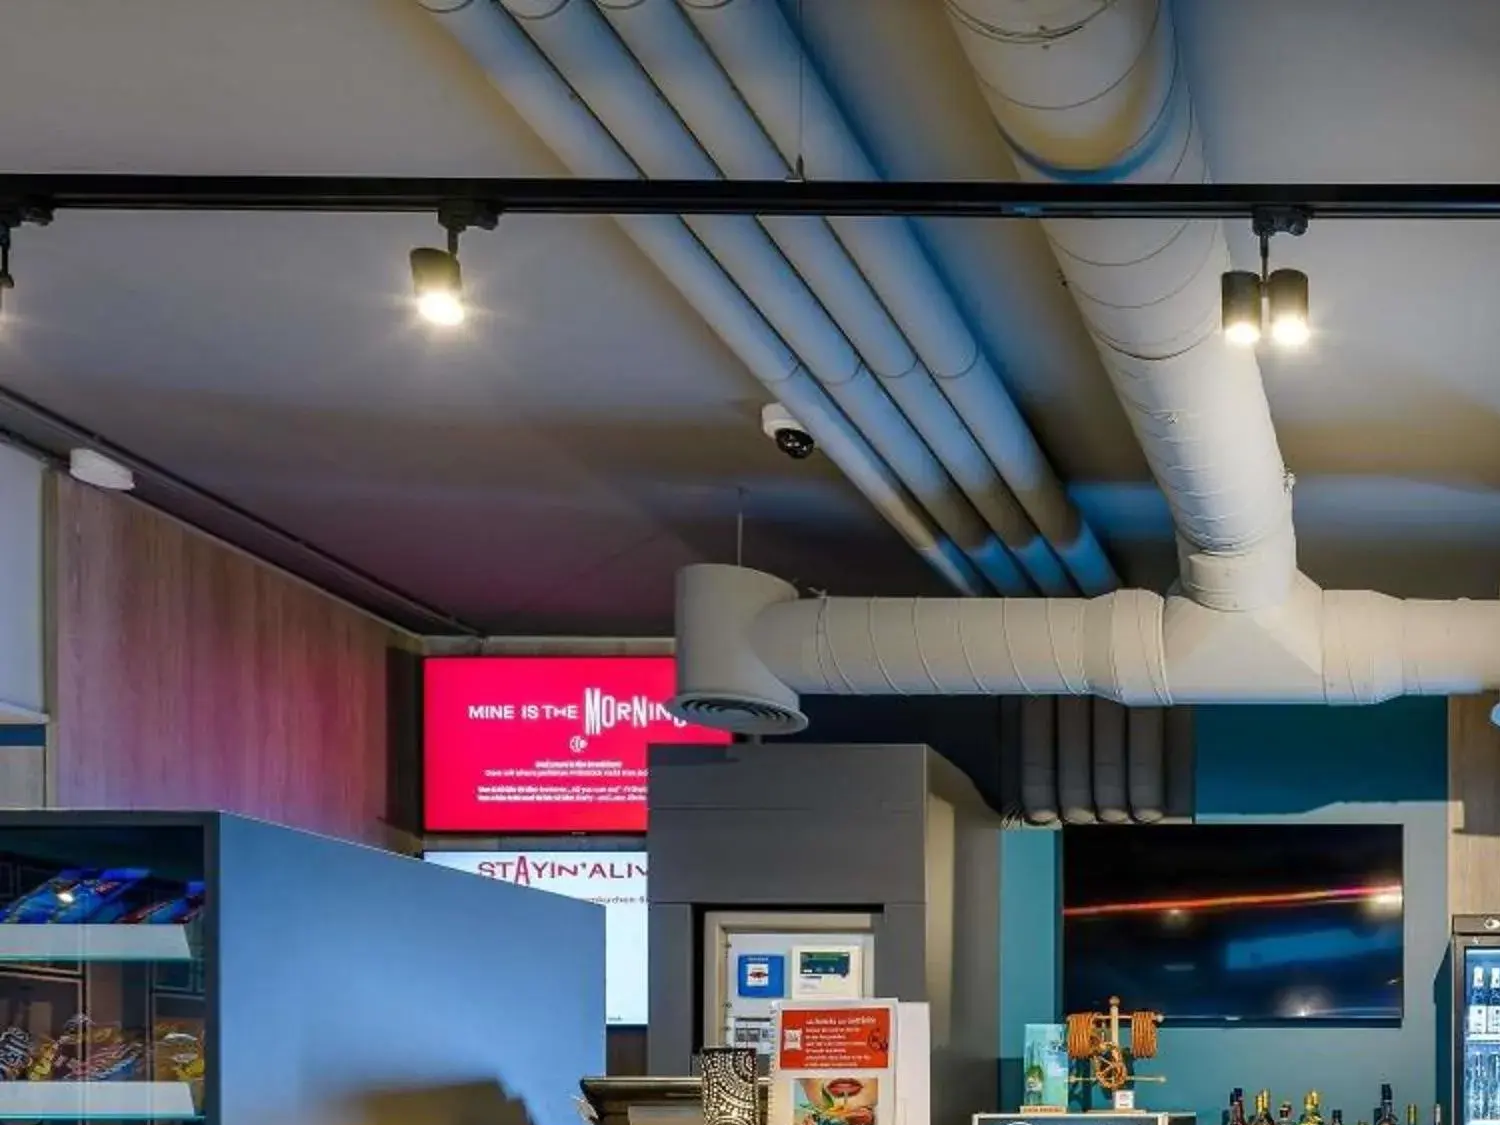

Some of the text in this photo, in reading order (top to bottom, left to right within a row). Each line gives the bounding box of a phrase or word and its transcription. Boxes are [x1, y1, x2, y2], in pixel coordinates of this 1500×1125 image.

[468, 705, 515, 719] MINE
[521, 705, 539, 719] IS
[541, 705, 578, 719] THE
